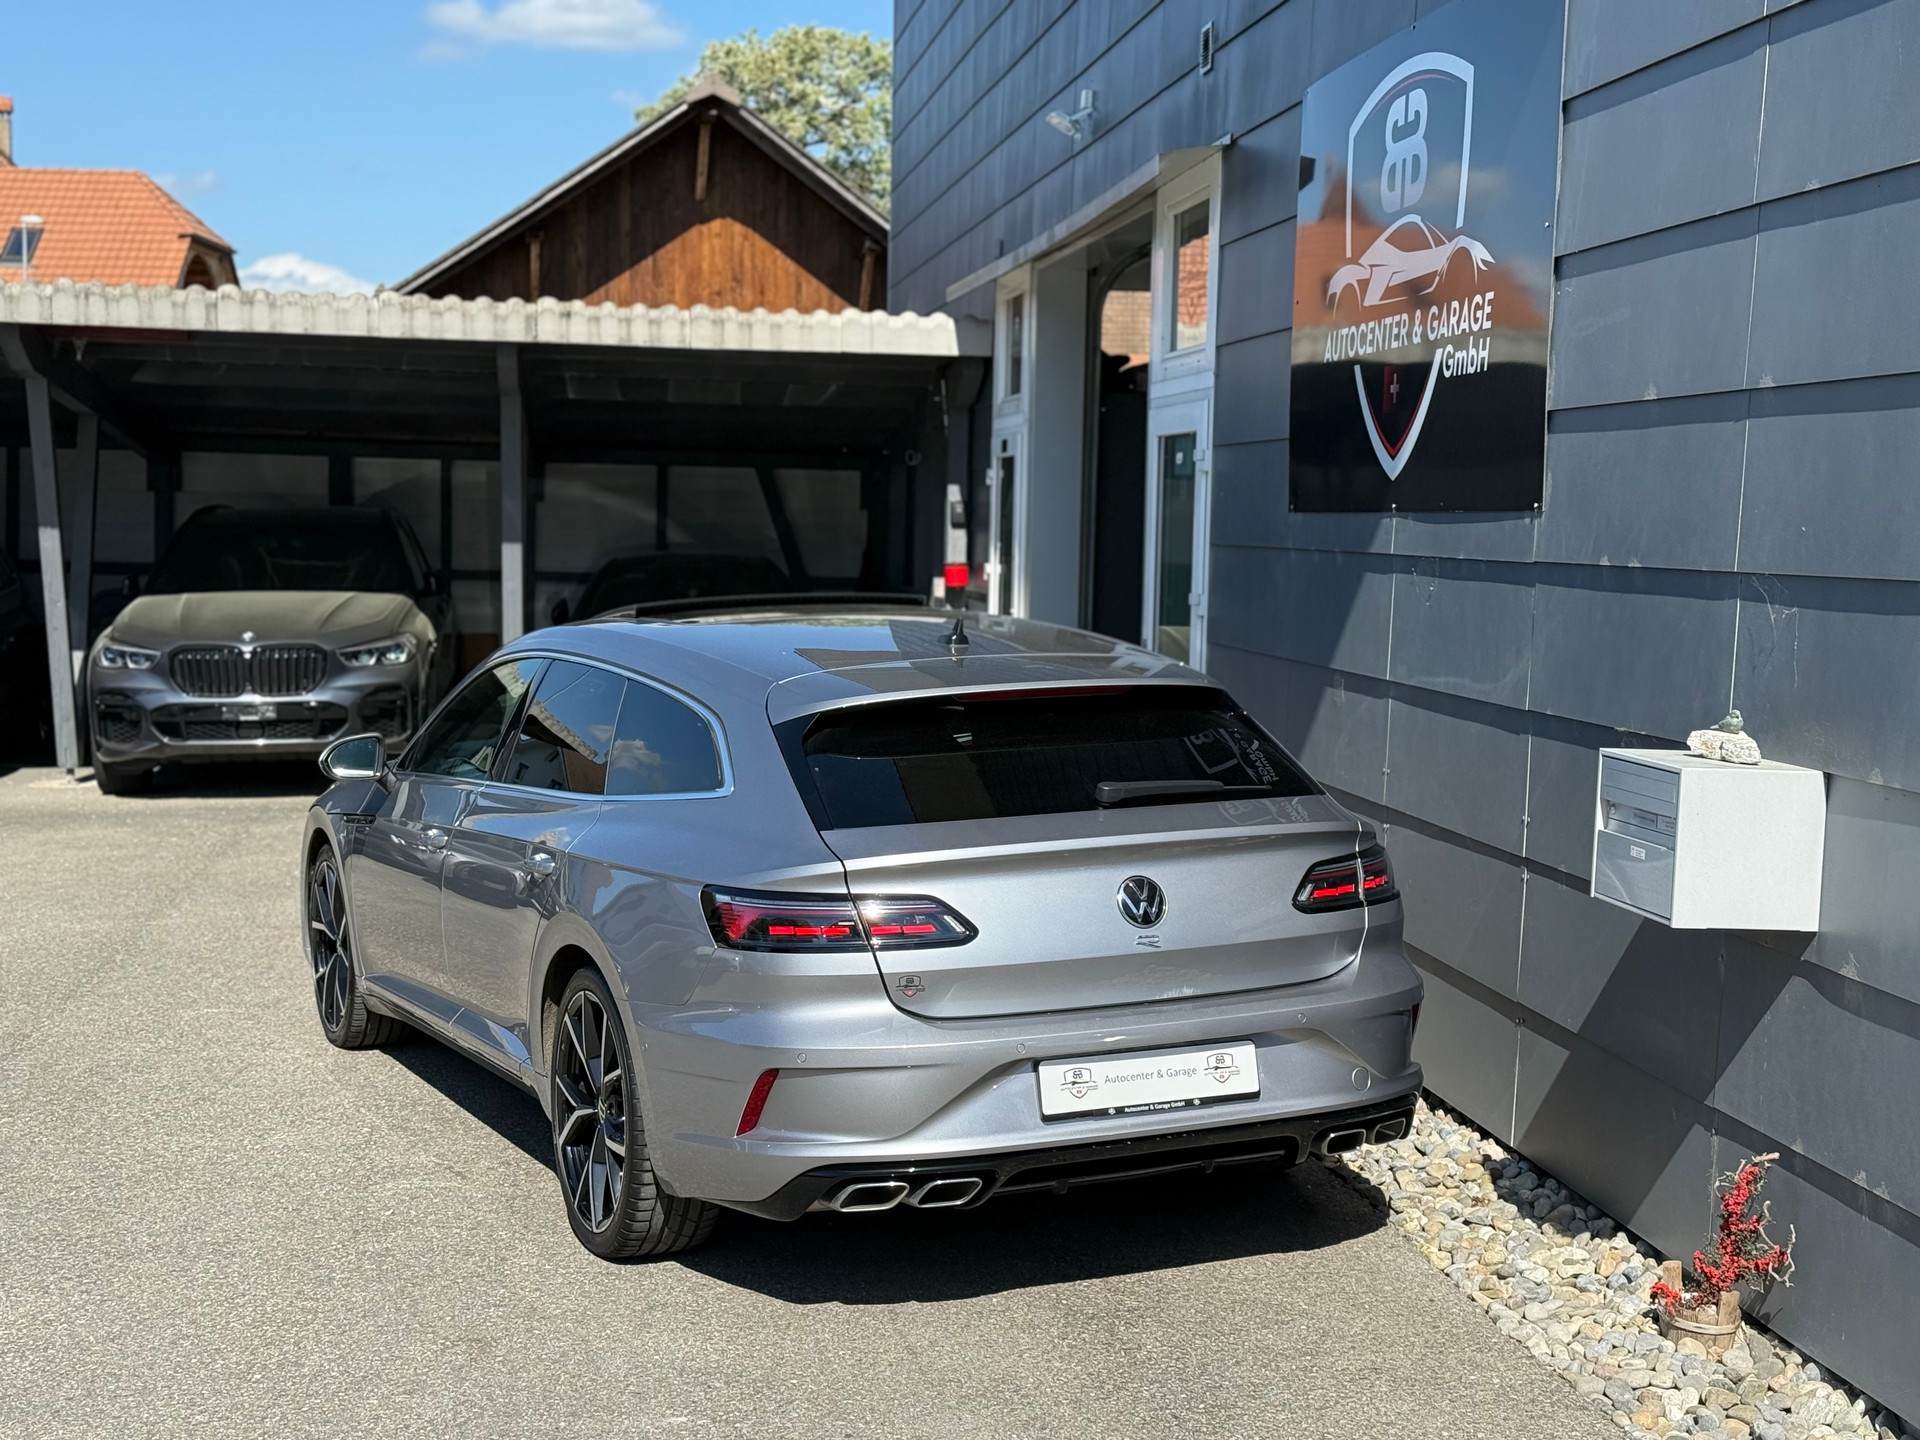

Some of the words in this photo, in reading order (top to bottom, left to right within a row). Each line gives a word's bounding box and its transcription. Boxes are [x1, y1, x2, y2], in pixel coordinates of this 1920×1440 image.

[1323, 313, 1410, 363] AUTOCENTER
[1412, 308, 1423, 345] &
[1427, 291, 1495, 341] GARAGE
[1442, 336, 1491, 379] GmbH
[1119, 877, 1163, 925] VW
[1104, 1071, 1155, 1085] Autocenter
[1156, 1069, 1164, 1079] &
[1166, 1067, 1198, 1078] Garage
